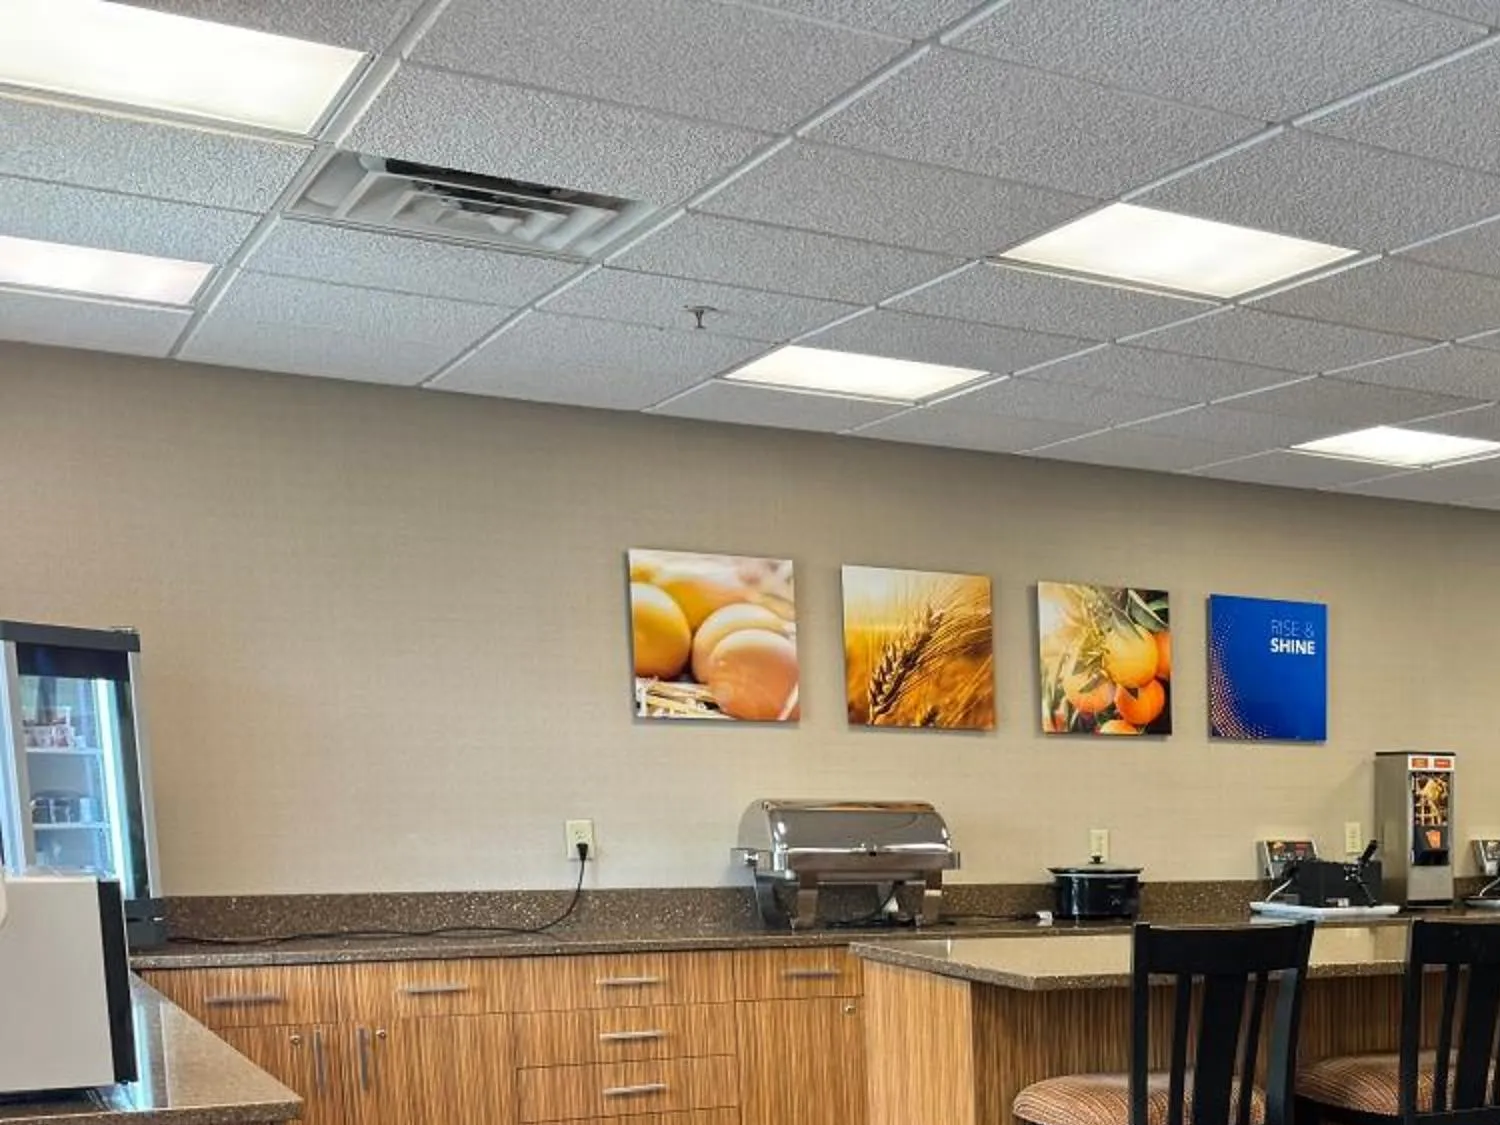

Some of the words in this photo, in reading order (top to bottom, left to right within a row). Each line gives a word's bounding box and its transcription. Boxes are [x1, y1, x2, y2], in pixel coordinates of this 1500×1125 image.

[1271, 619, 1299, 637] RISE
[1304, 622, 1314, 638] &
[1270, 637, 1316, 655] SHINE
